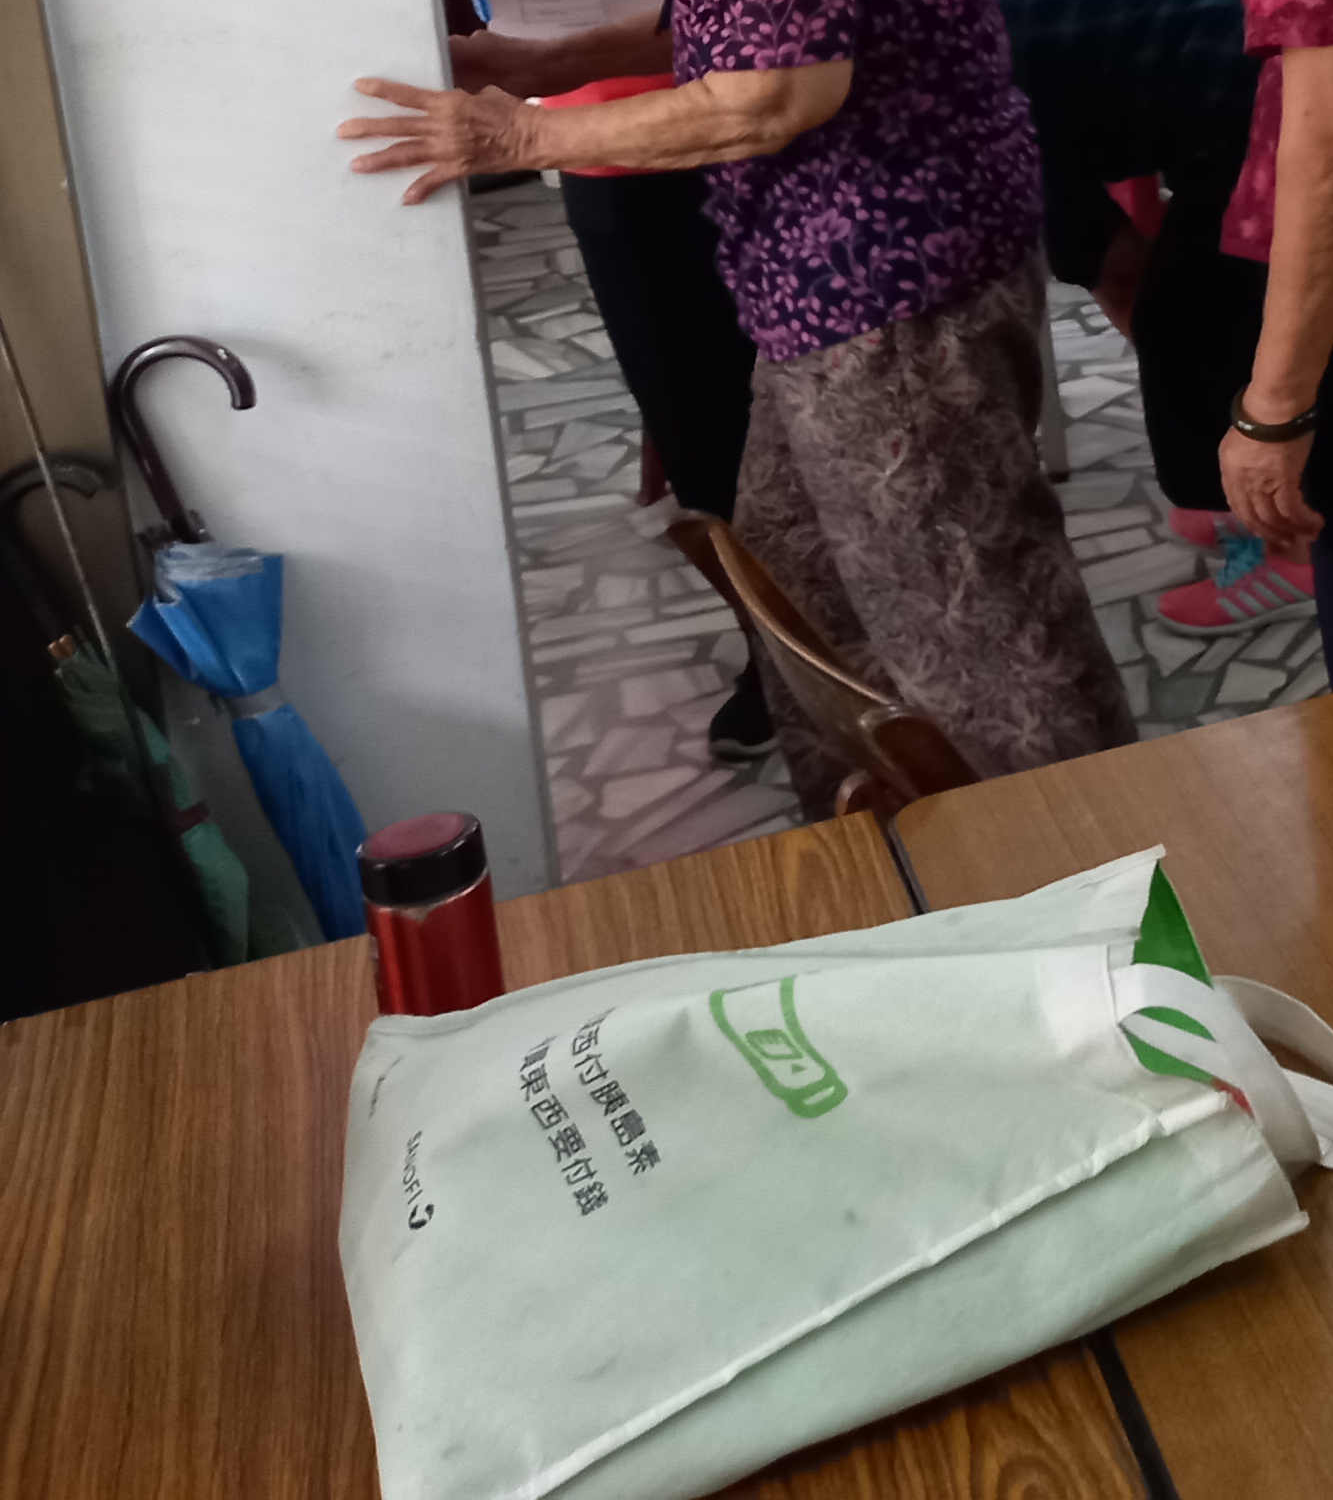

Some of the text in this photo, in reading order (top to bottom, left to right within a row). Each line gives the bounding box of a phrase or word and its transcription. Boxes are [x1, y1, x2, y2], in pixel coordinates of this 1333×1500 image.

[519, 1033, 610, 1217] 買東西要付錢
[571, 1007, 662, 1176] 西付胰島素
